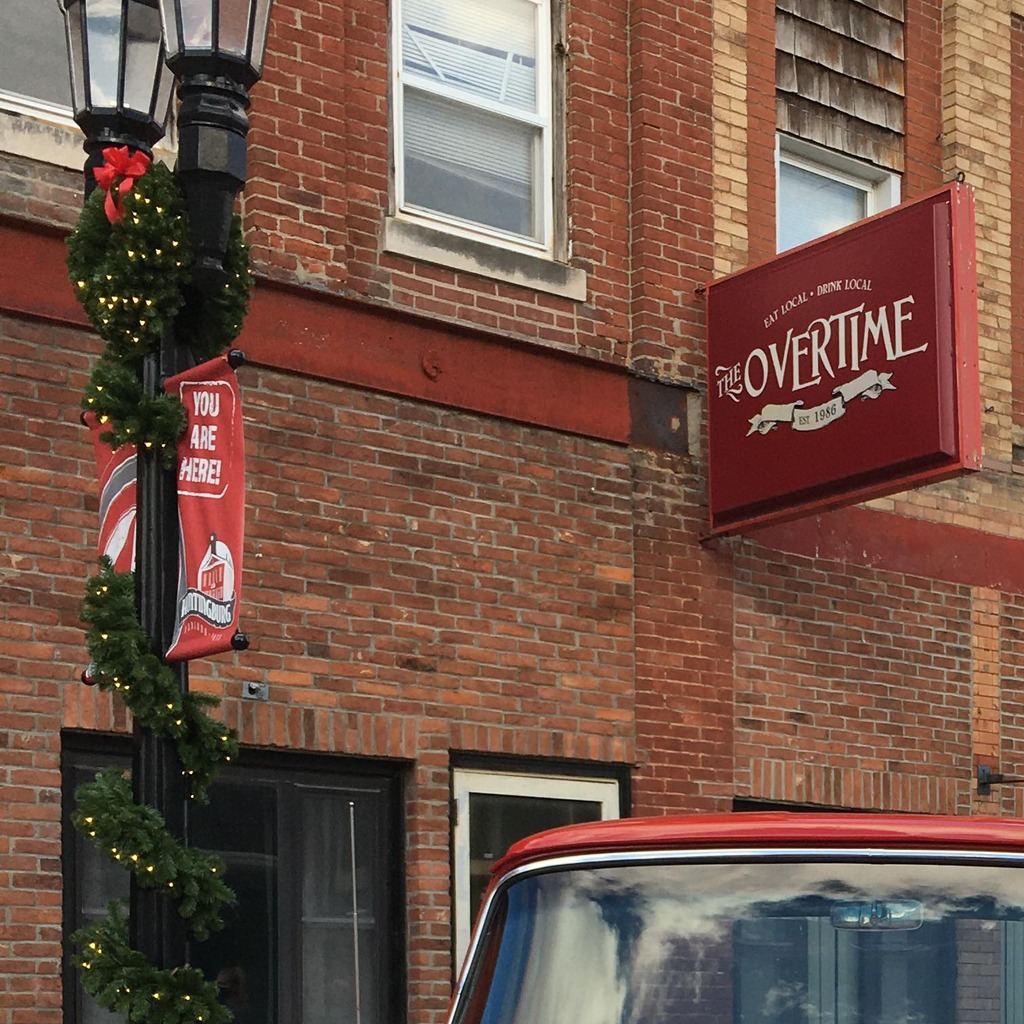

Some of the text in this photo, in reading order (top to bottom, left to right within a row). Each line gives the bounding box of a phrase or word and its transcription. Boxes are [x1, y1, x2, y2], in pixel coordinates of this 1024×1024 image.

[763, 279, 872, 328] EAT LOCAL DRINK LOCAL
[715, 295, 928, 402] THE OVERTIME
[193, 391, 220, 417] YOU
[799, 403, 837, 425] EST 1986
[190, 425, 218, 451] ARE
[179, 457, 222, 485] HERE!
